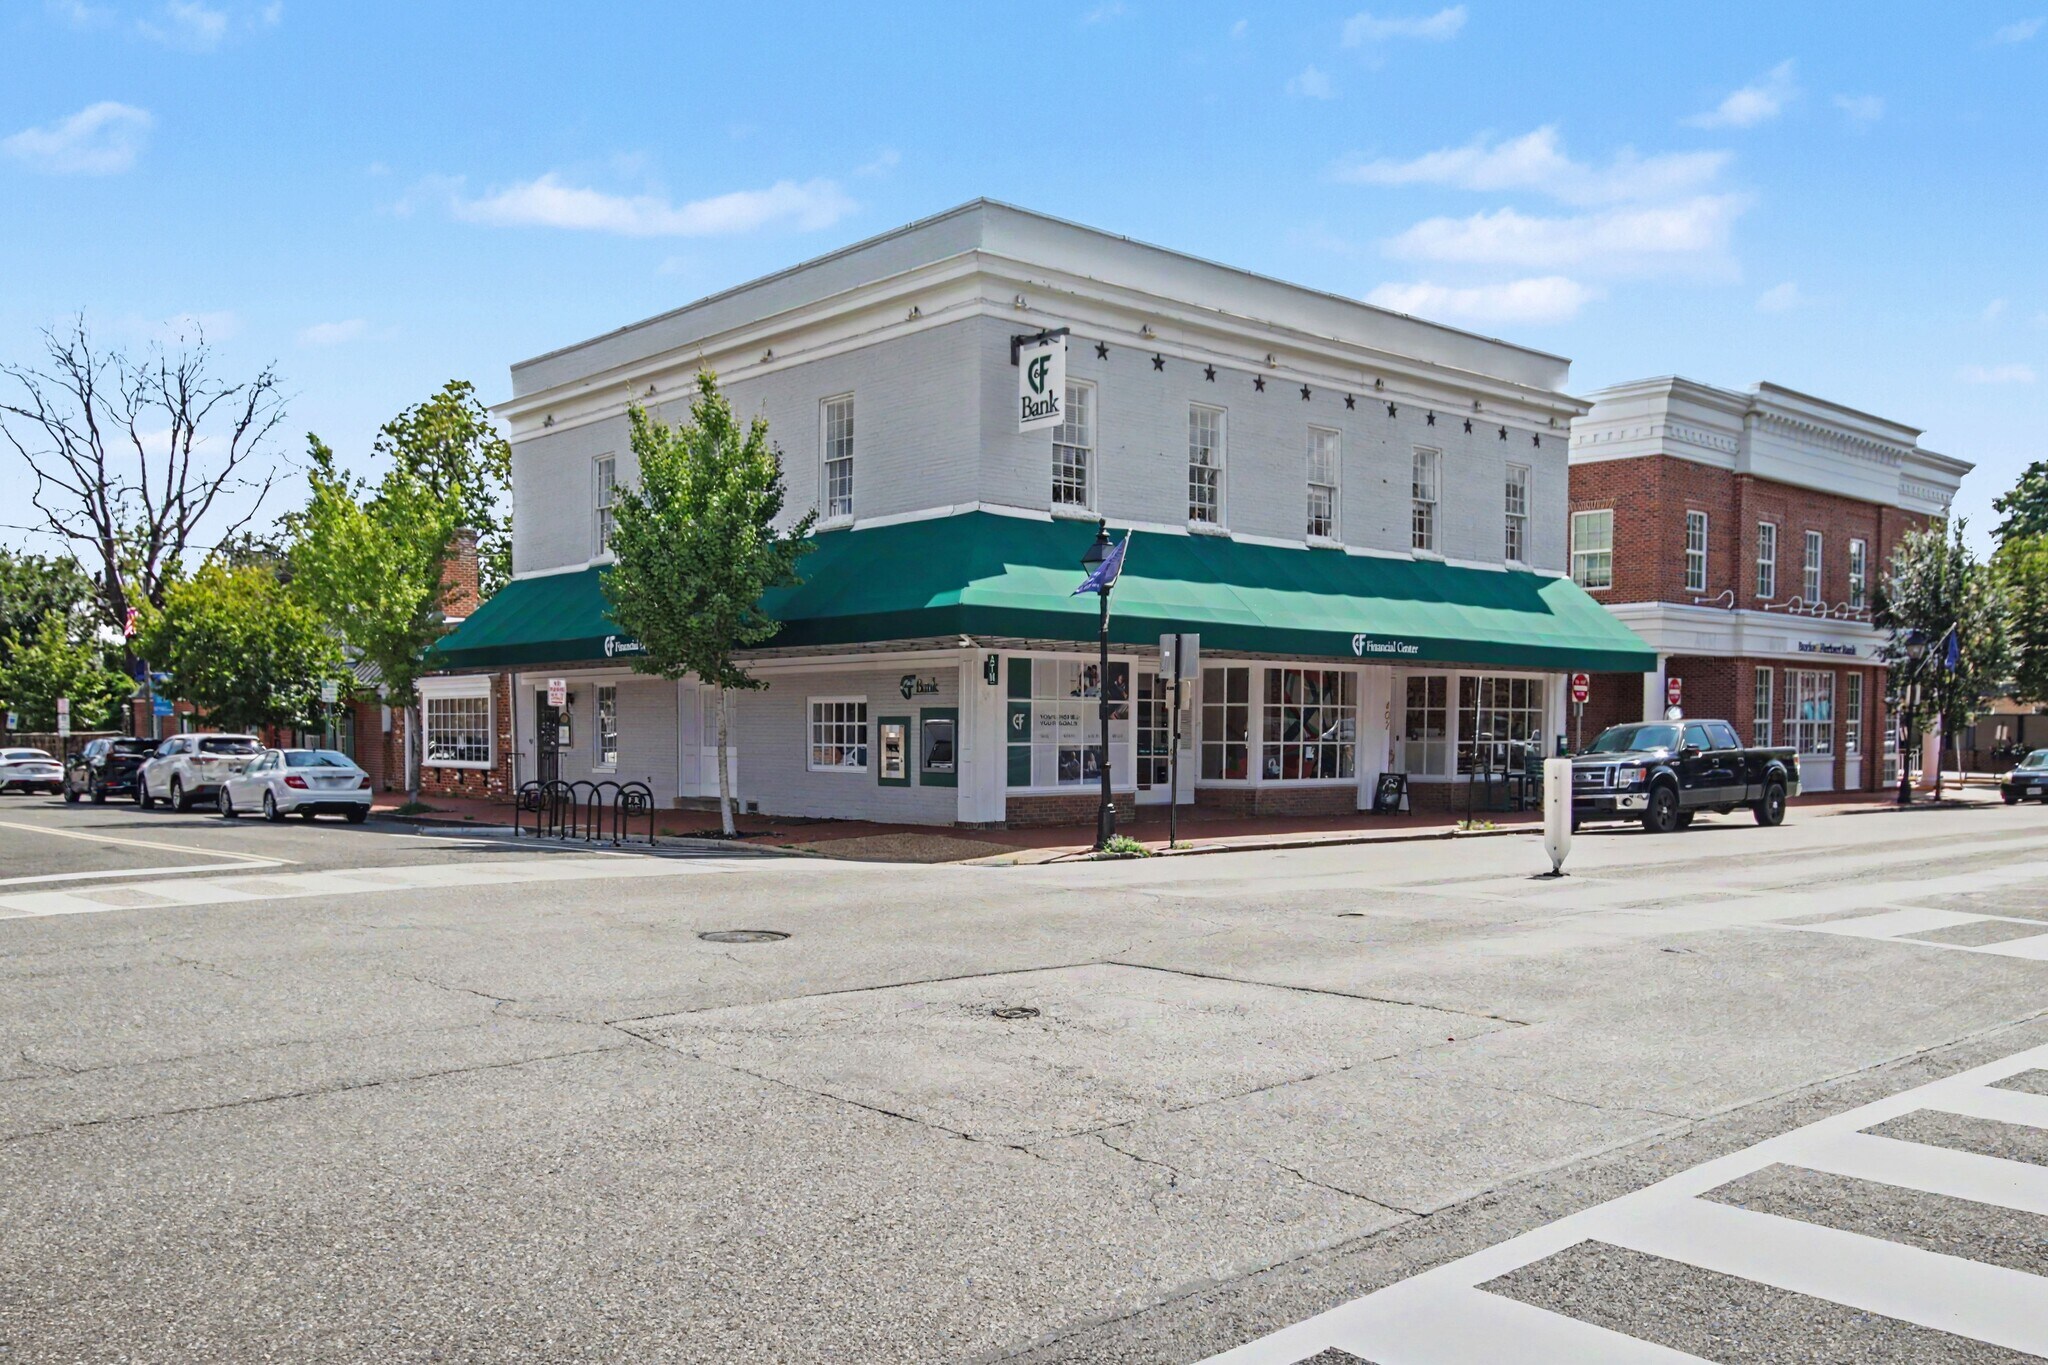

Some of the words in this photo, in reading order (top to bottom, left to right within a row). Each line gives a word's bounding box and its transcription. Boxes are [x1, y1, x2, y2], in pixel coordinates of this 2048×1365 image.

[1021, 389, 1060, 419] Bank
[615, 639, 639, 652] Financial
[1367, 641, 1396, 653] Financial
[1397, 642, 1419, 654] Center
[916, 677, 939, 693] Bank
